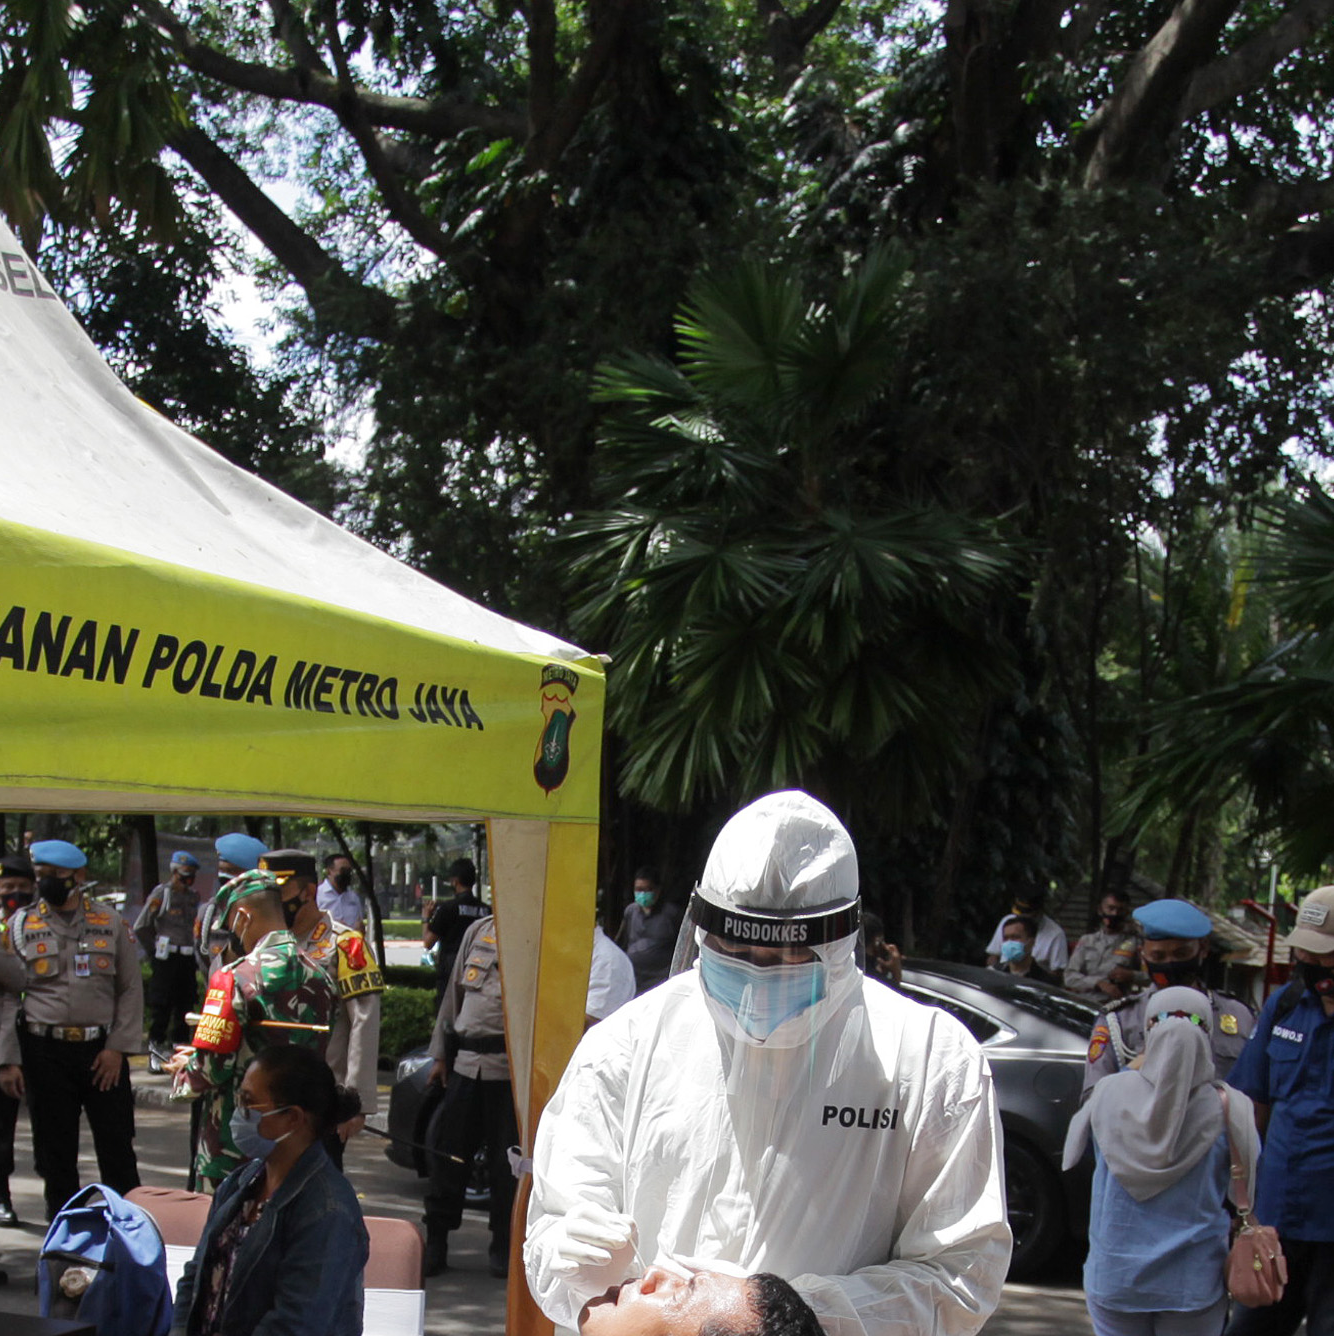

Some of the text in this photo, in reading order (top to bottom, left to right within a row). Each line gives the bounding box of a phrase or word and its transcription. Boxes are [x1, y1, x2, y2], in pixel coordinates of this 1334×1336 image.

[142, 633, 278, 707] POLDA
[284, 660, 400, 721] METRO
[408, 682, 485, 731] JAYA
[724, 916, 808, 943] PUSDOKKES
[821, 1105, 900, 1131] POLISI
